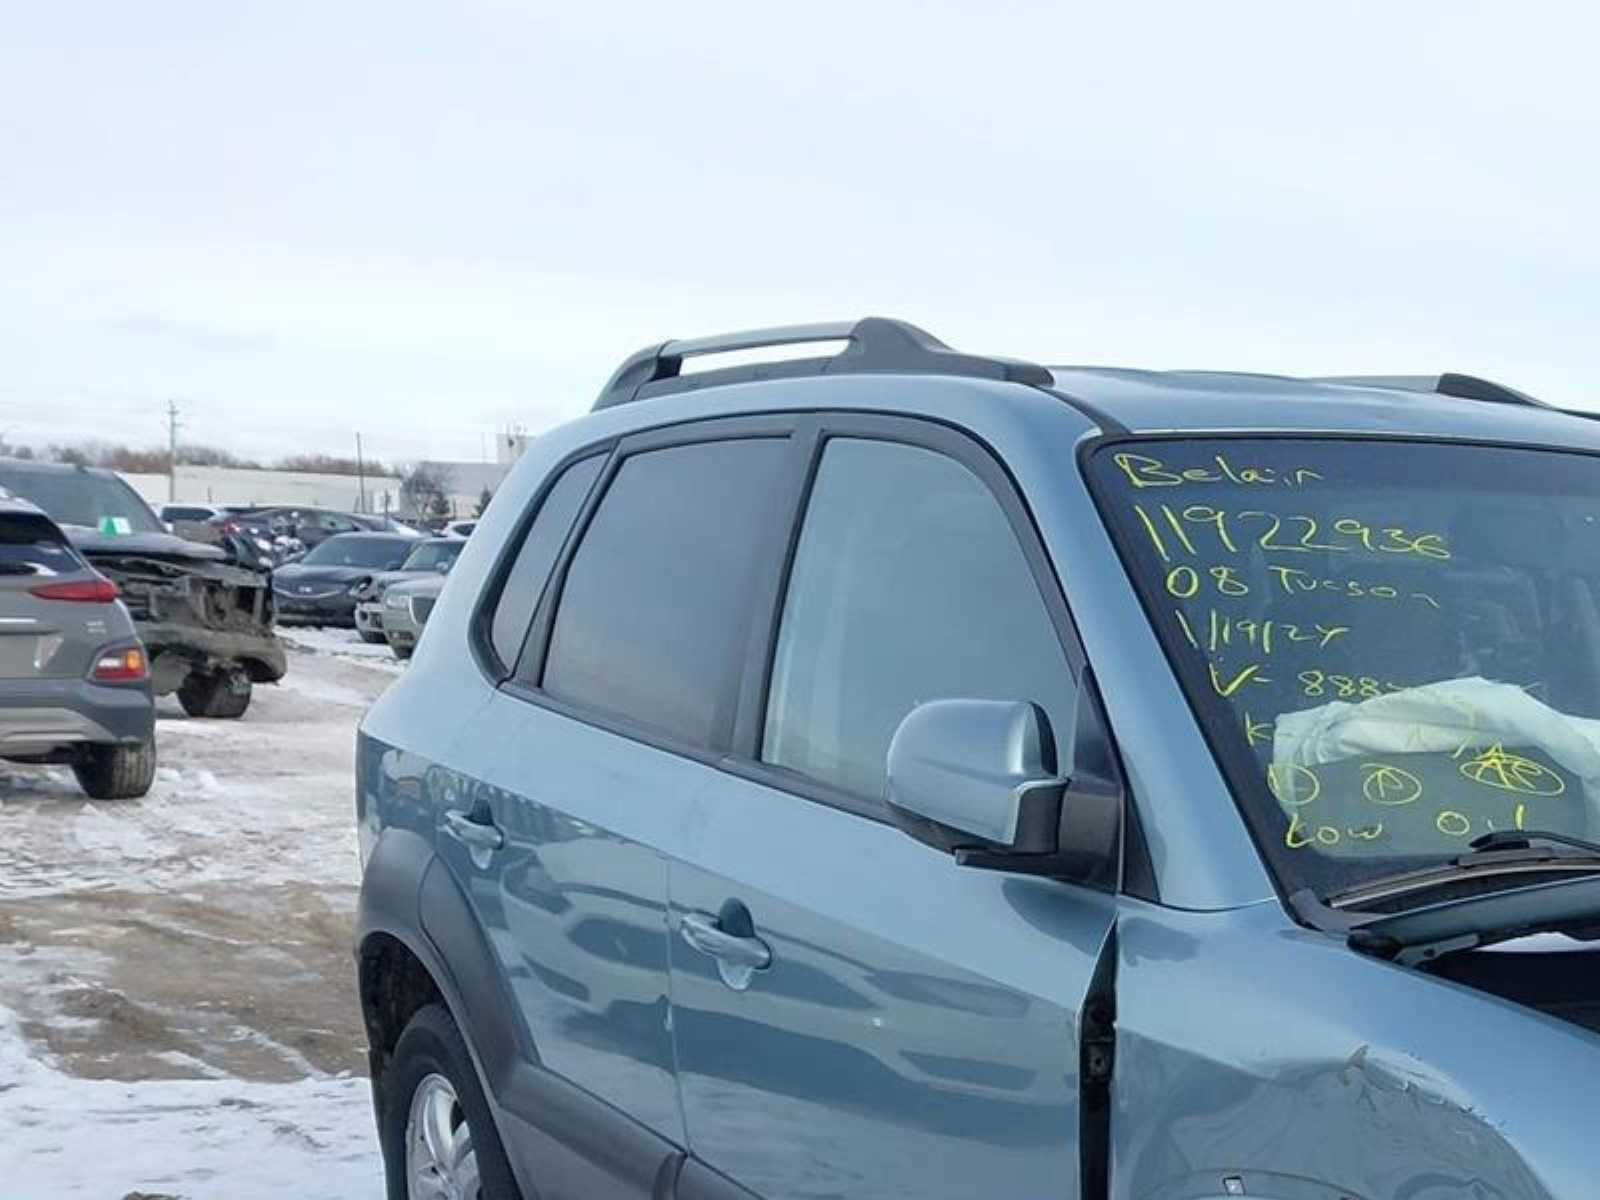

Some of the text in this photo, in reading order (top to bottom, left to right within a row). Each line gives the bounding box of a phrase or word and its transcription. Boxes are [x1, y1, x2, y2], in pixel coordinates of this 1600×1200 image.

[1114, 453, 1323, 488] Belair
[1135, 504, 1451, 561] 11922936
[1166, 565, 1250, 599] 08
